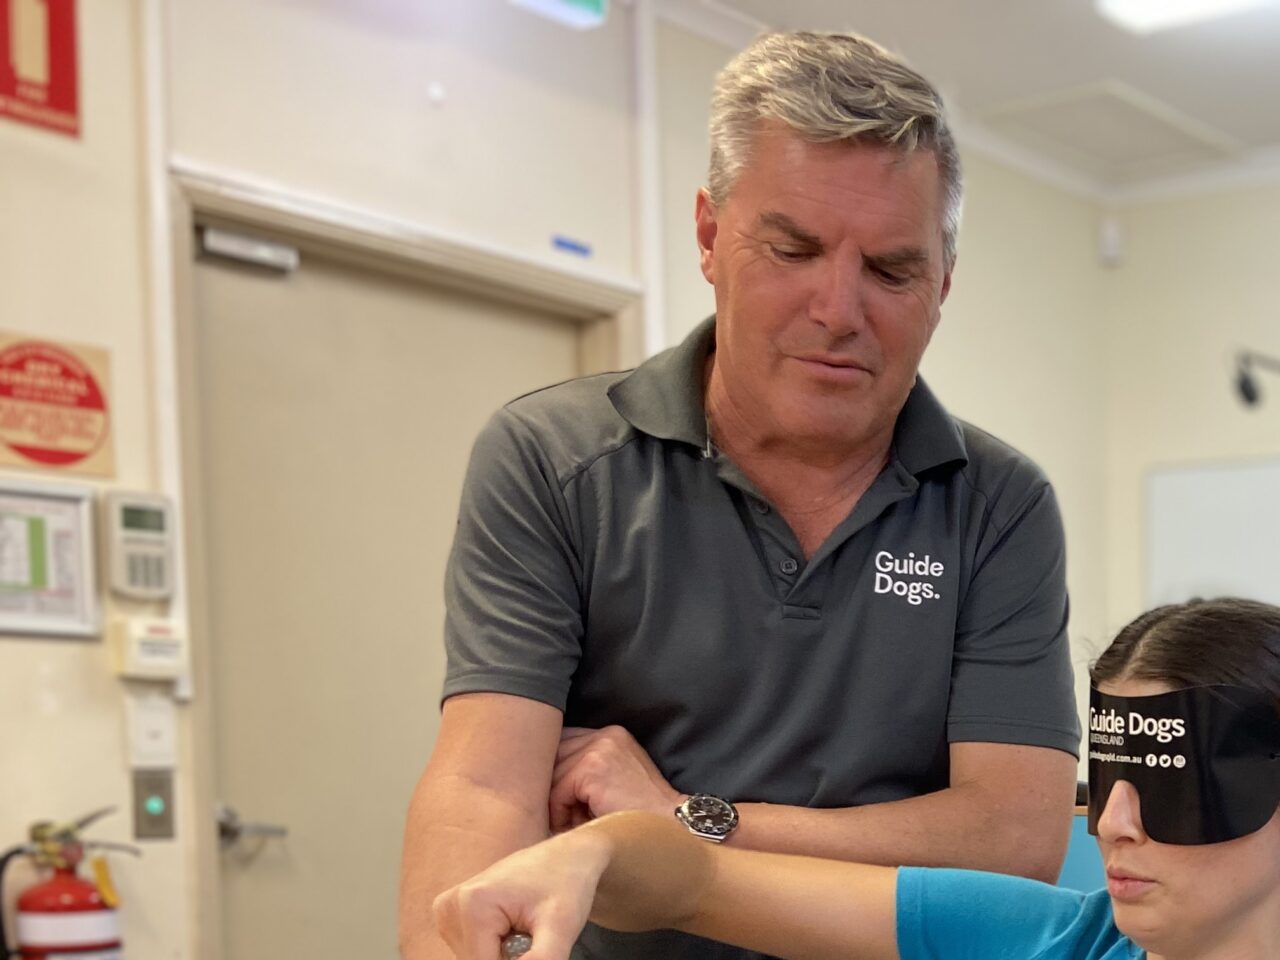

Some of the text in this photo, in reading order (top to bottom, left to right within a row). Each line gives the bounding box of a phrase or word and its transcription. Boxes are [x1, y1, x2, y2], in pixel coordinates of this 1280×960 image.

[875, 551, 944, 577] Guide
[874, 572, 940, 605] Dogs.
[1089, 707, 1185, 743] Guide Dogs
